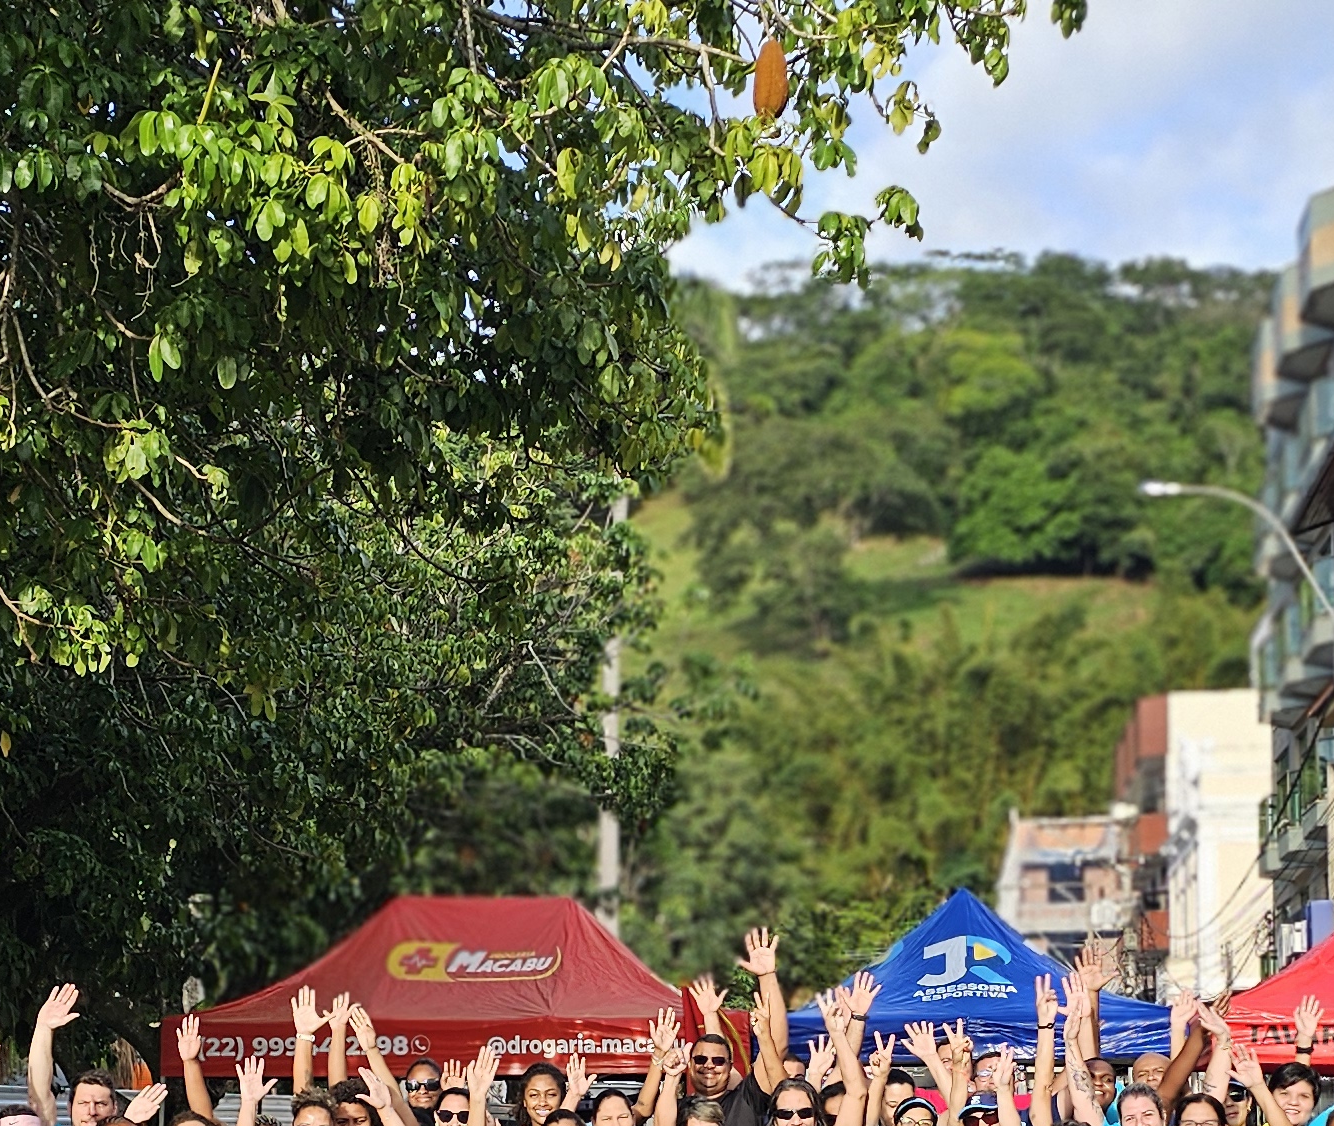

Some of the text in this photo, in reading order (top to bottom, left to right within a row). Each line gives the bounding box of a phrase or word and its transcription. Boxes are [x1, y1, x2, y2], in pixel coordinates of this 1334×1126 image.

[913, 982, 1018, 998] ASSESSORIA
[921, 990, 1008, 1002] ESPORTIVA
[487, 1033, 686, 1059] @drogaria.macau
